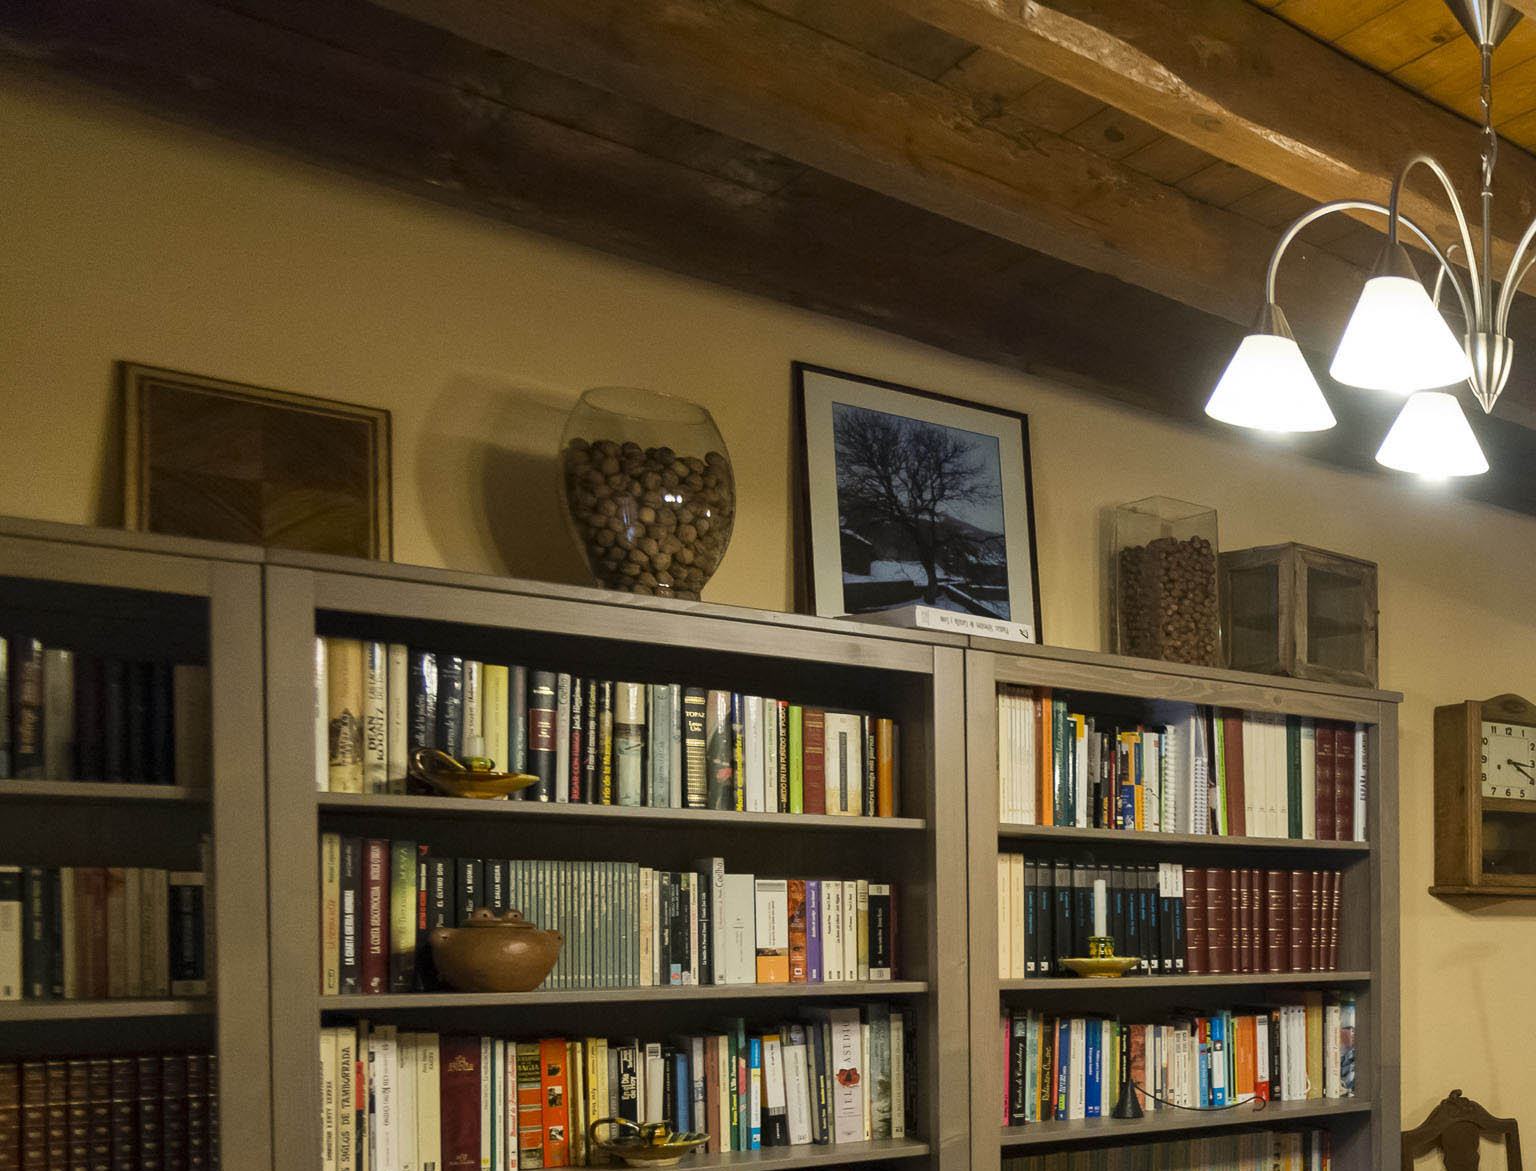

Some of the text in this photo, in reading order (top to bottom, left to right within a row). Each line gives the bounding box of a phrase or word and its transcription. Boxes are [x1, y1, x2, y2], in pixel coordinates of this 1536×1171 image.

[558, 678, 568, 704] Coelho
[367, 715, 377, 750] DEAN
[376, 707, 385, 760] KOONTZ
[1505, 727, 1512, 736] 12
[1521, 729, 1525, 737] 1
[1530, 743, 1535, 751] 2
[1481, 755, 1487, 764] 9
[1530, 760, 1535, 768] 3
[1481, 773, 1487, 781] 8
[1491, 787, 1496, 795] 7
[1505, 788, 1511, 797] 6
[1520, 789, 1525, 798] 5
[715, 862, 724, 887] Coelho
[436, 900, 443, 908] EL
[494, 900, 501, 908] LA
[370, 946, 381, 954] LA
[344, 958, 355, 966] LA
[341, 1046, 351, 1109] TAMBORRADA
[620, 1091, 630, 1100] En
[341, 1113, 351, 1125] DE
[341, 1131, 351, 1162] SIGLOS
